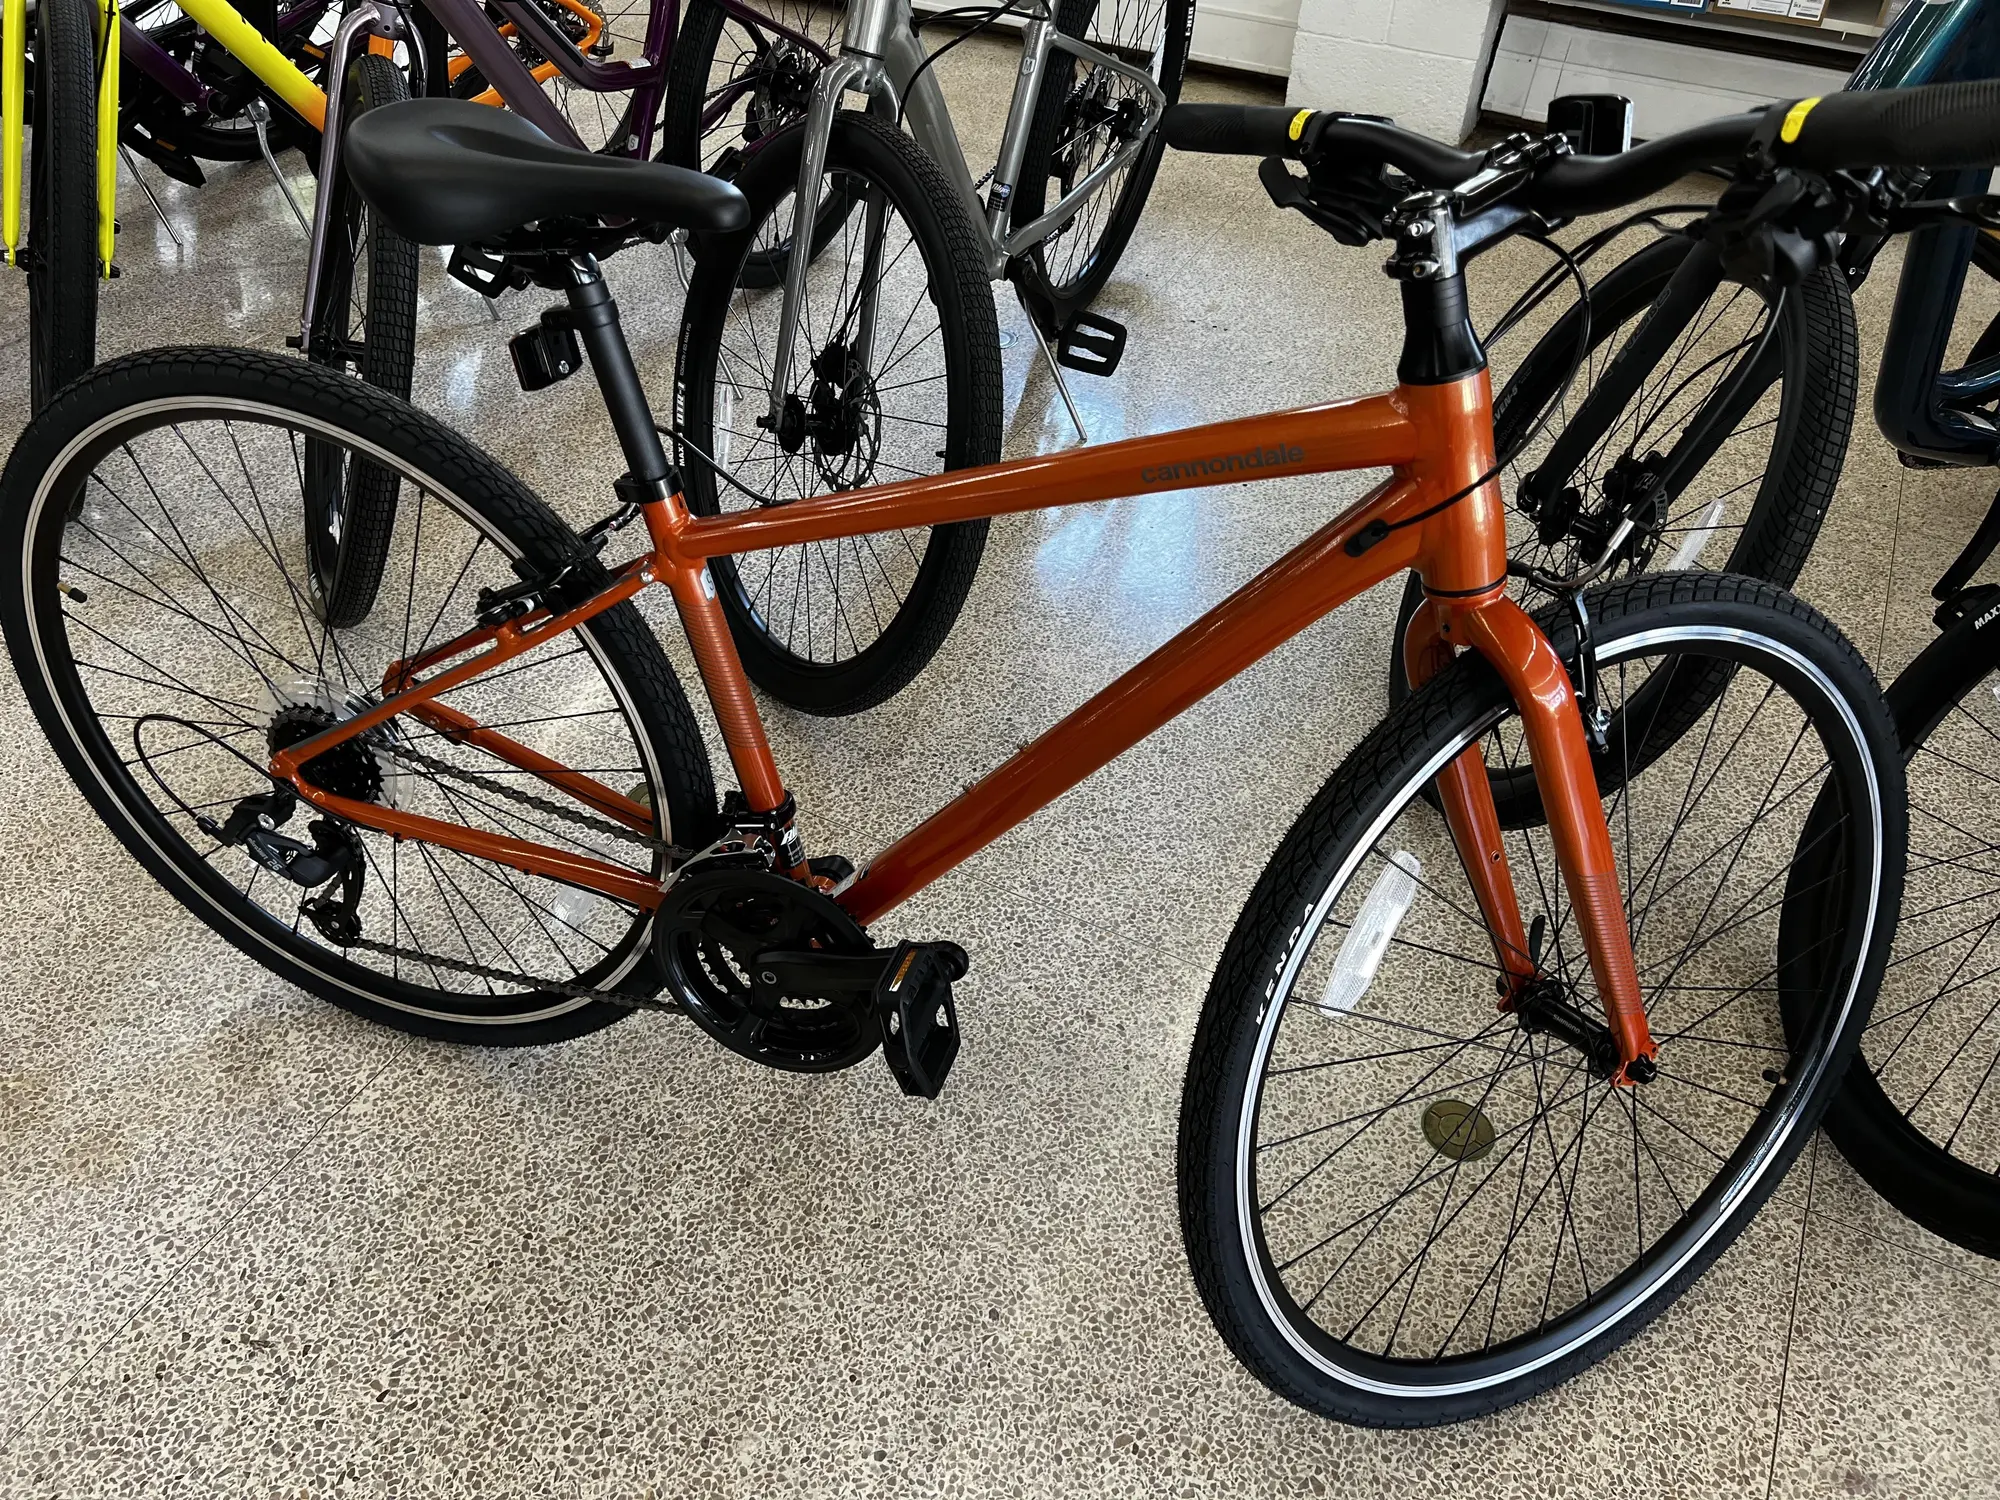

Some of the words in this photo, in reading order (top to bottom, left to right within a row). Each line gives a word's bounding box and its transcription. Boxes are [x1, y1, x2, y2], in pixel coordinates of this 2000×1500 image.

[677, 432, 685, 467] MAXS
[1141, 443, 1305, 484] cannondale
[1255, 903, 1315, 1026] KENDA
